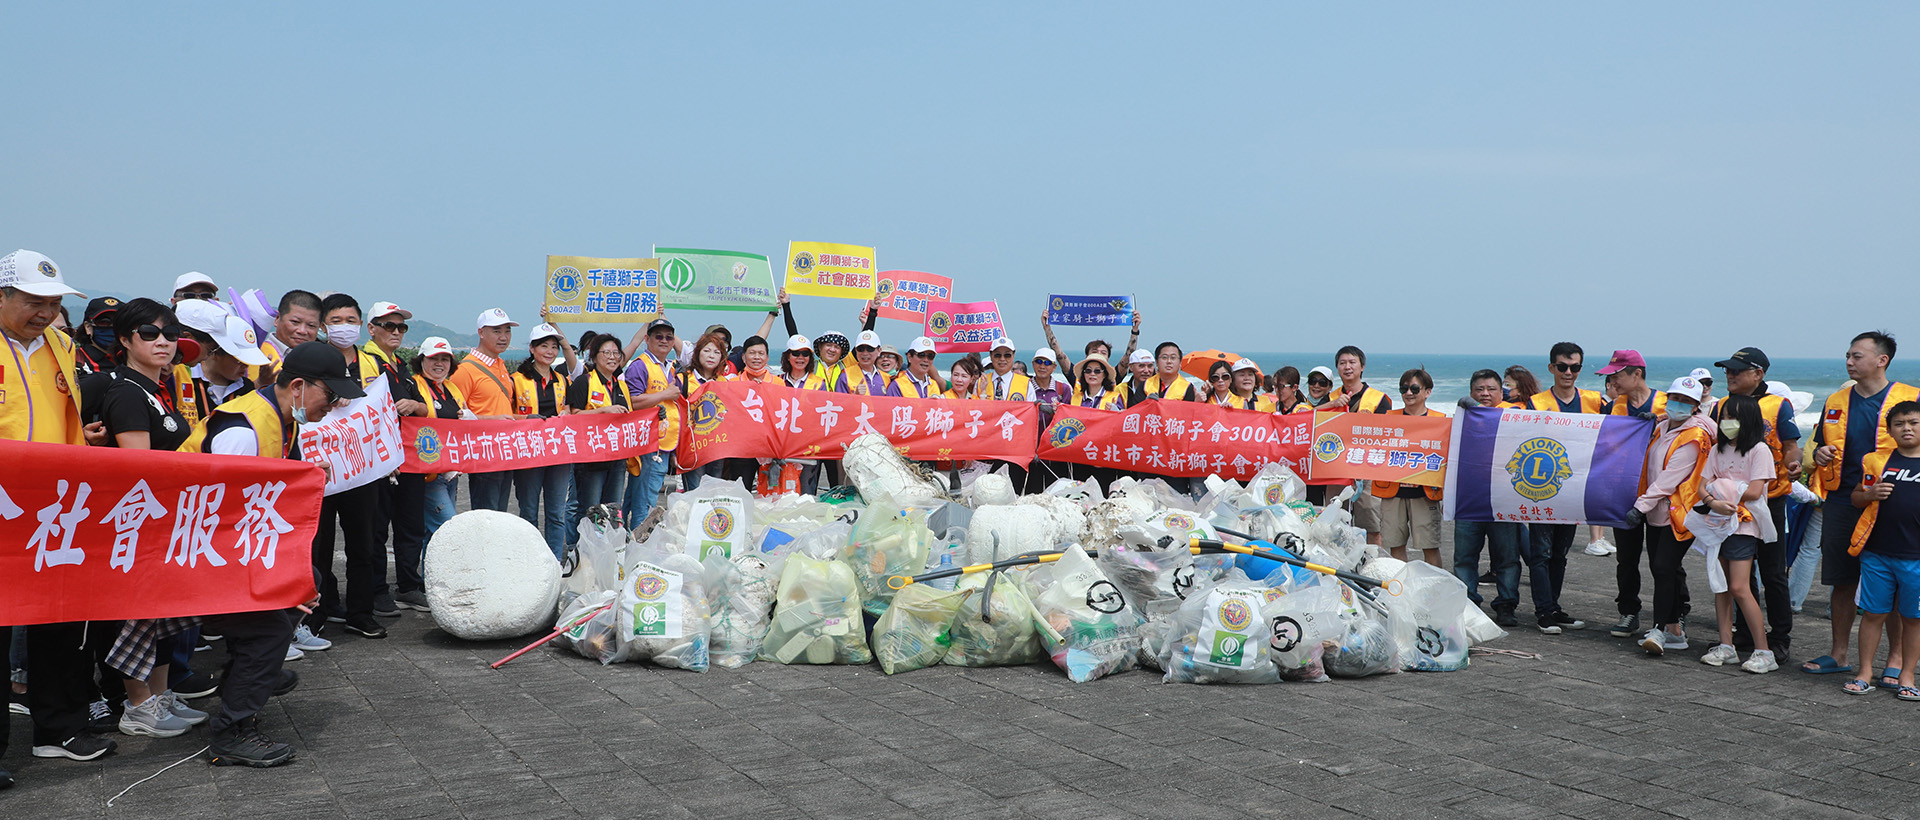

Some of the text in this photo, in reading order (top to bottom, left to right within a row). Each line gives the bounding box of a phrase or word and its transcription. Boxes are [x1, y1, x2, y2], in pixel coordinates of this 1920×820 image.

[819, 254, 870, 269] 翔順獅子會
[563, 277, 572, 289] L
[587, 269, 657, 287] 千禧獅子會
[817, 271, 871, 289] 社會服務
[897, 280, 948, 299] 萬華獅子會
[586, 291, 657, 313] 社會服務
[954, 311, 998, 325] 萬華獅子會
[1051, 313, 1130, 324] 皇家騎士獅子會
[953, 327, 1002, 343] 公益活動
[697, 404, 712, 422] L
[740, 388, 1024, 442] 台北市太陽獅子會
[1502, 413, 1601, 430] 國際獅子會300-A2區
[1122, 413, 1311, 446] 國際獅子會300A2區
[1352, 425, 1405, 437] 國際獅子會
[425, 438, 434, 451] L
[446, 419, 653, 464] 台北市信德獅子會 社會服務
[689, 433, 728, 452] 300-A2
[1325, 443, 1333, 452] L
[1351, 437, 1442, 450] 300A2區第一專區
[1523, 439, 1563, 455] LIONS
[1346, 447, 1445, 471] 建華獅子會
[1530, 457, 1547, 480] L
[1519, 504, 1554, 517] 台北市
